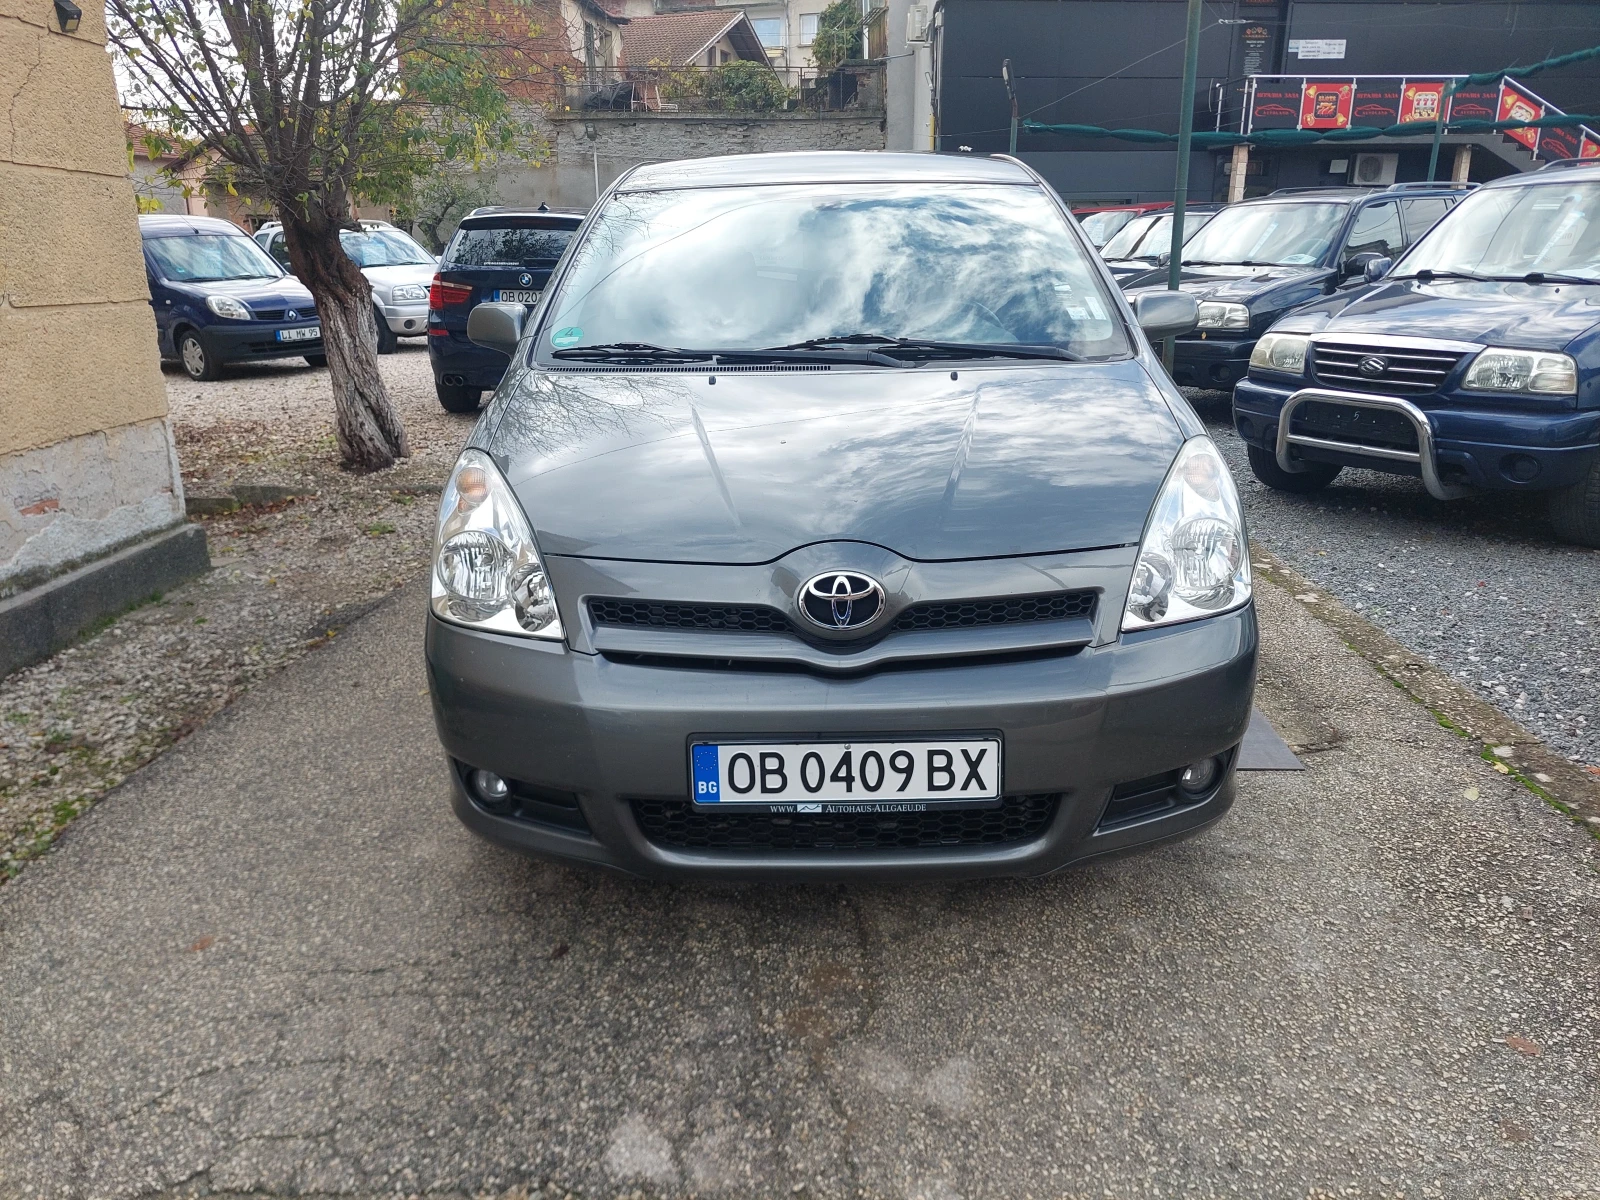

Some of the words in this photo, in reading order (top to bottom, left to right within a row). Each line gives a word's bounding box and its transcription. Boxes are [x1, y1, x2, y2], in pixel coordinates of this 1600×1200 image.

[501, 291, 516, 302] OB
[517, 291, 542, 303] 020
[564, 327, 574, 337] 4
[727, 752, 788, 794] OB
[800, 750, 915, 794] 0409
[927, 748, 988, 792] BX
[698, 781, 718, 794] BG
